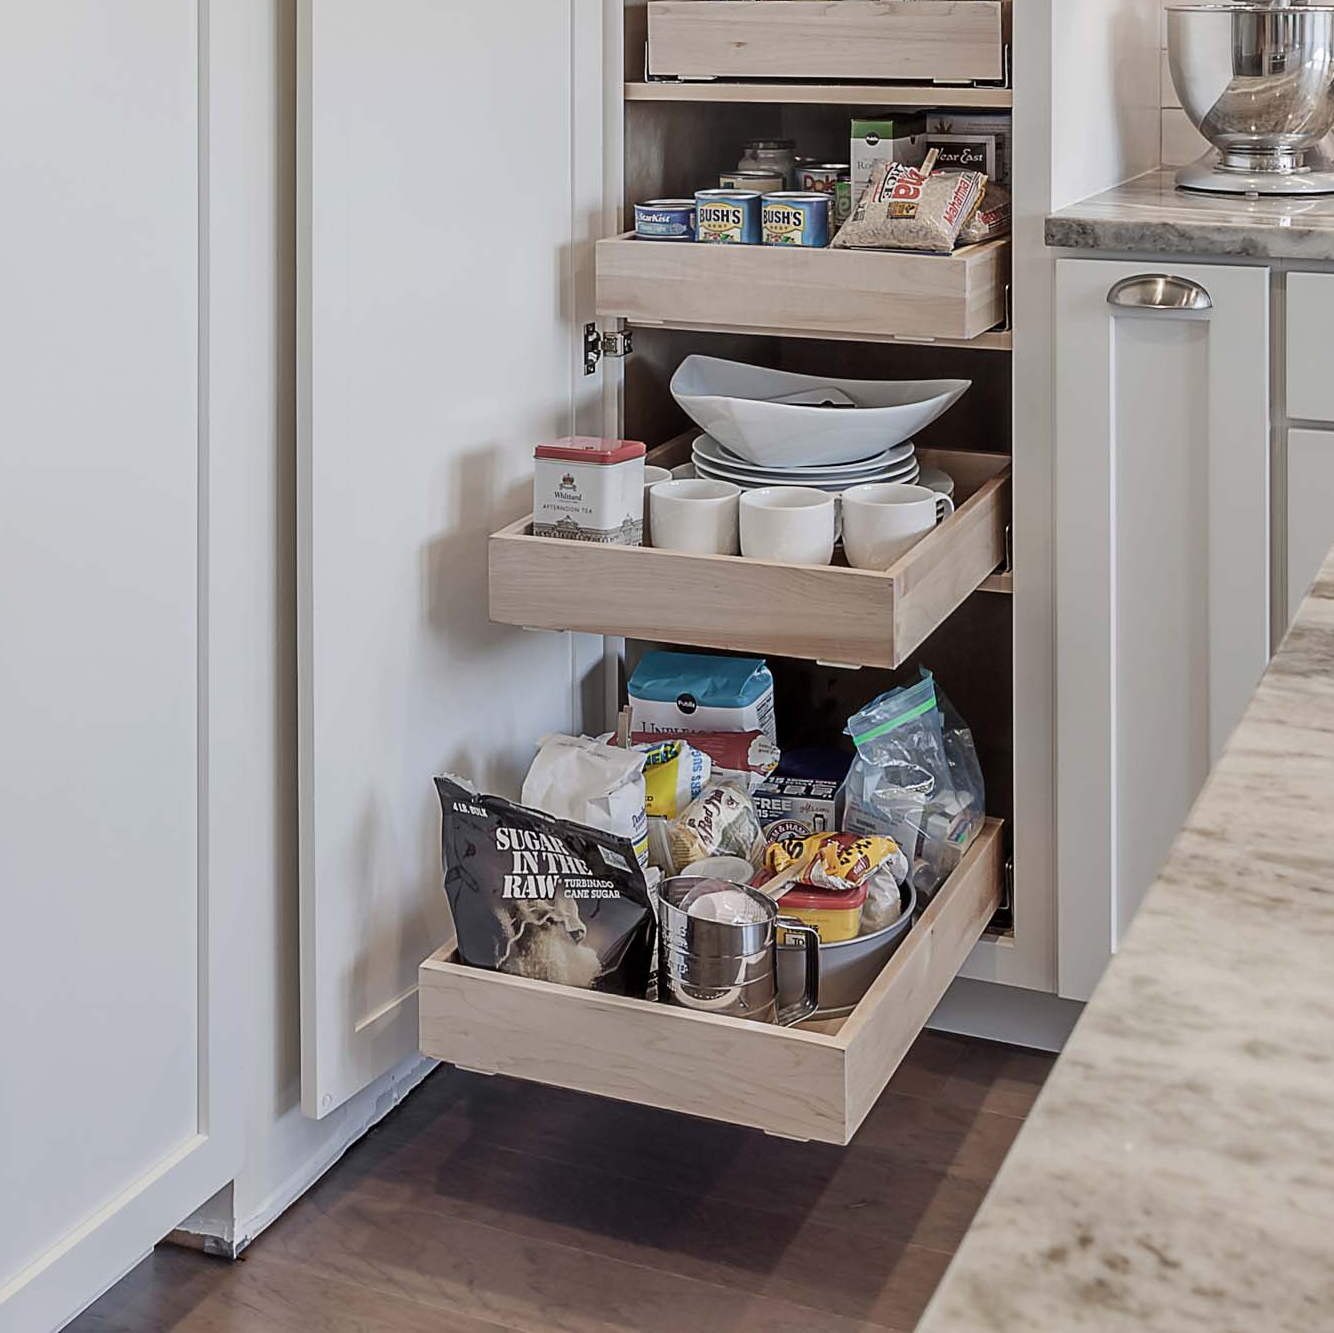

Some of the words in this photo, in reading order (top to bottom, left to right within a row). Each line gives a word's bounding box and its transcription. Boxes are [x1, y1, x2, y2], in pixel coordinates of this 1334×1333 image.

[960, 147, 984, 164] East
[943, 178, 971, 227] Mahatma
[638, 212, 671, 223] StarKist
[699, 208, 741, 225] BUSH'S
[763, 209, 802, 227] BUSH'S
[453, 802, 459, 812] 4
[753, 797, 792, 811] FREE
[495, 827, 570, 855] SUGAR
[512, 850, 540, 875] IN
[542, 851, 593, 876] THE
[501, 874, 560, 899] RAW
[564, 878, 615, 890] TURBINADO
[564, 889, 590, 899] CANE
[591, 889, 621, 899] SUGAR
